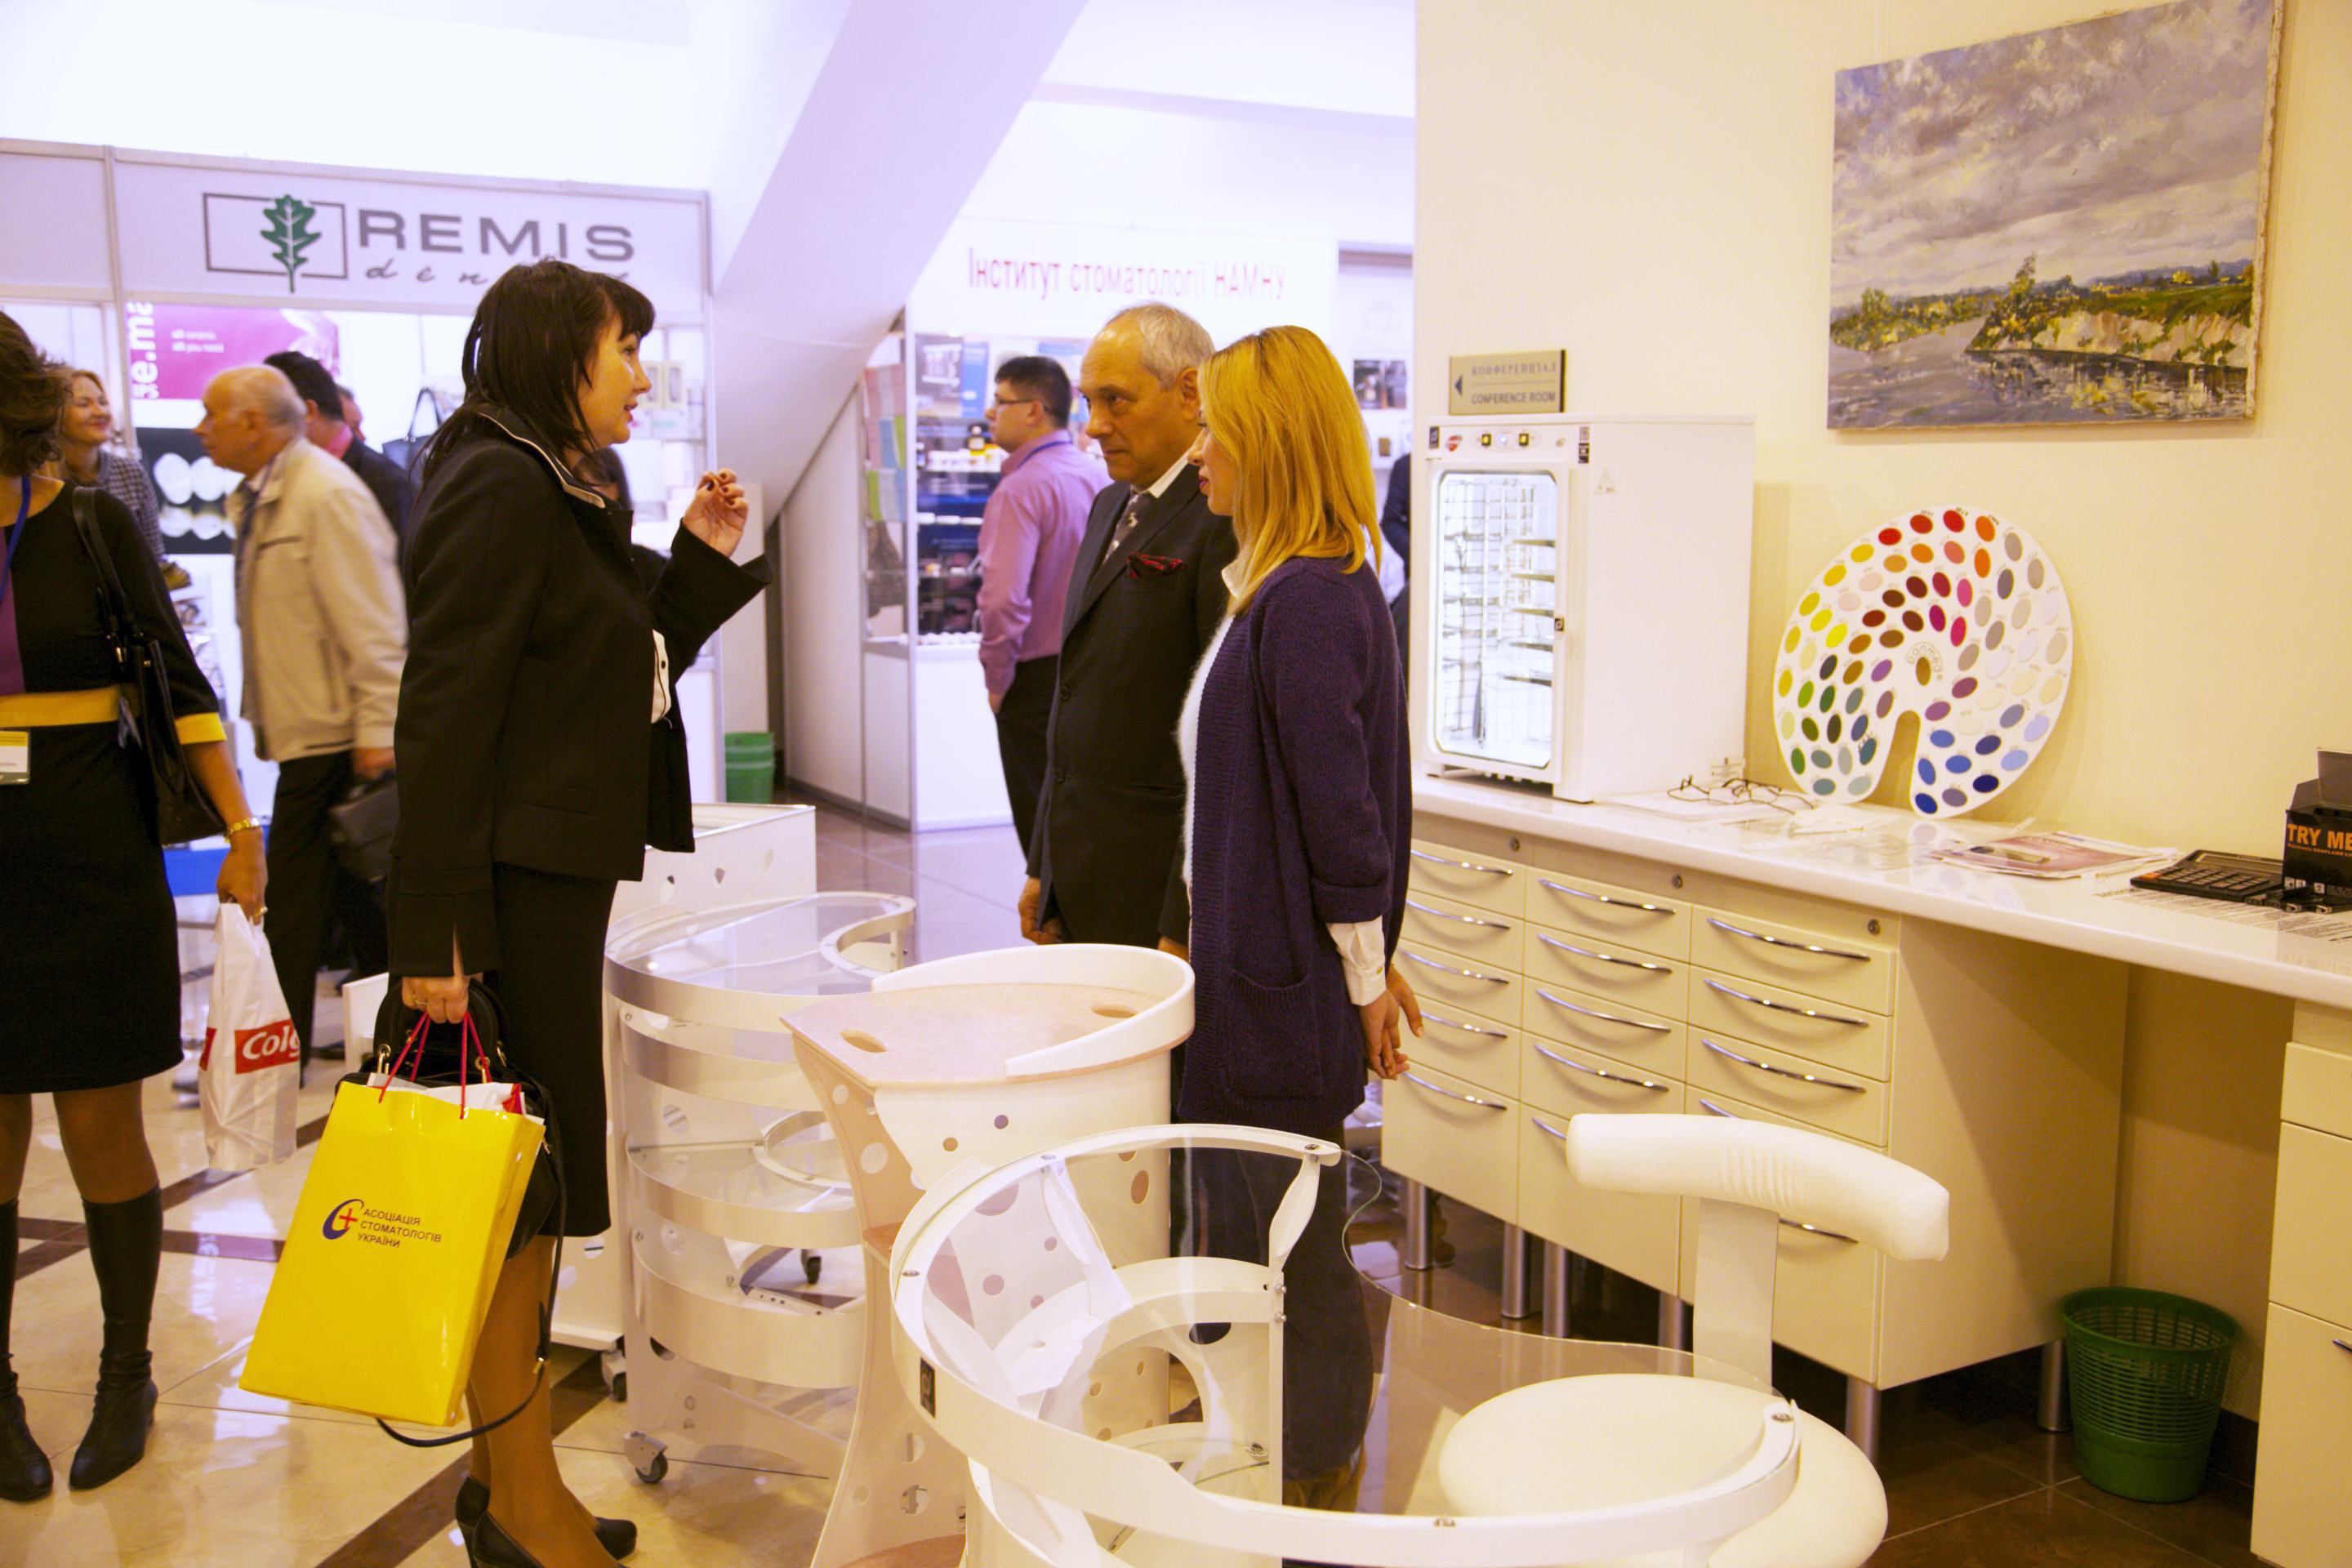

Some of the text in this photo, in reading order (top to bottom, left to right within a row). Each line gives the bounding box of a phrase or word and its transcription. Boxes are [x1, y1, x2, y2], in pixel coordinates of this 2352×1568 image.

[358, 208, 635, 262] REMIS
[969, 247, 1062, 301] Інститут
[1070, 261, 1206, 297] стоматології
[1471, 391, 1556, 405] CONFERENCE ROOM
[2287, 823, 2352, 851] TRY ME
[363, 1209, 421, 1226] АСОЦІАЦІЯ
[357, 1232, 400, 1248] УКРАЇНИ
[360, 1221, 442, 1242] СТОМАТОЛОГІВ
